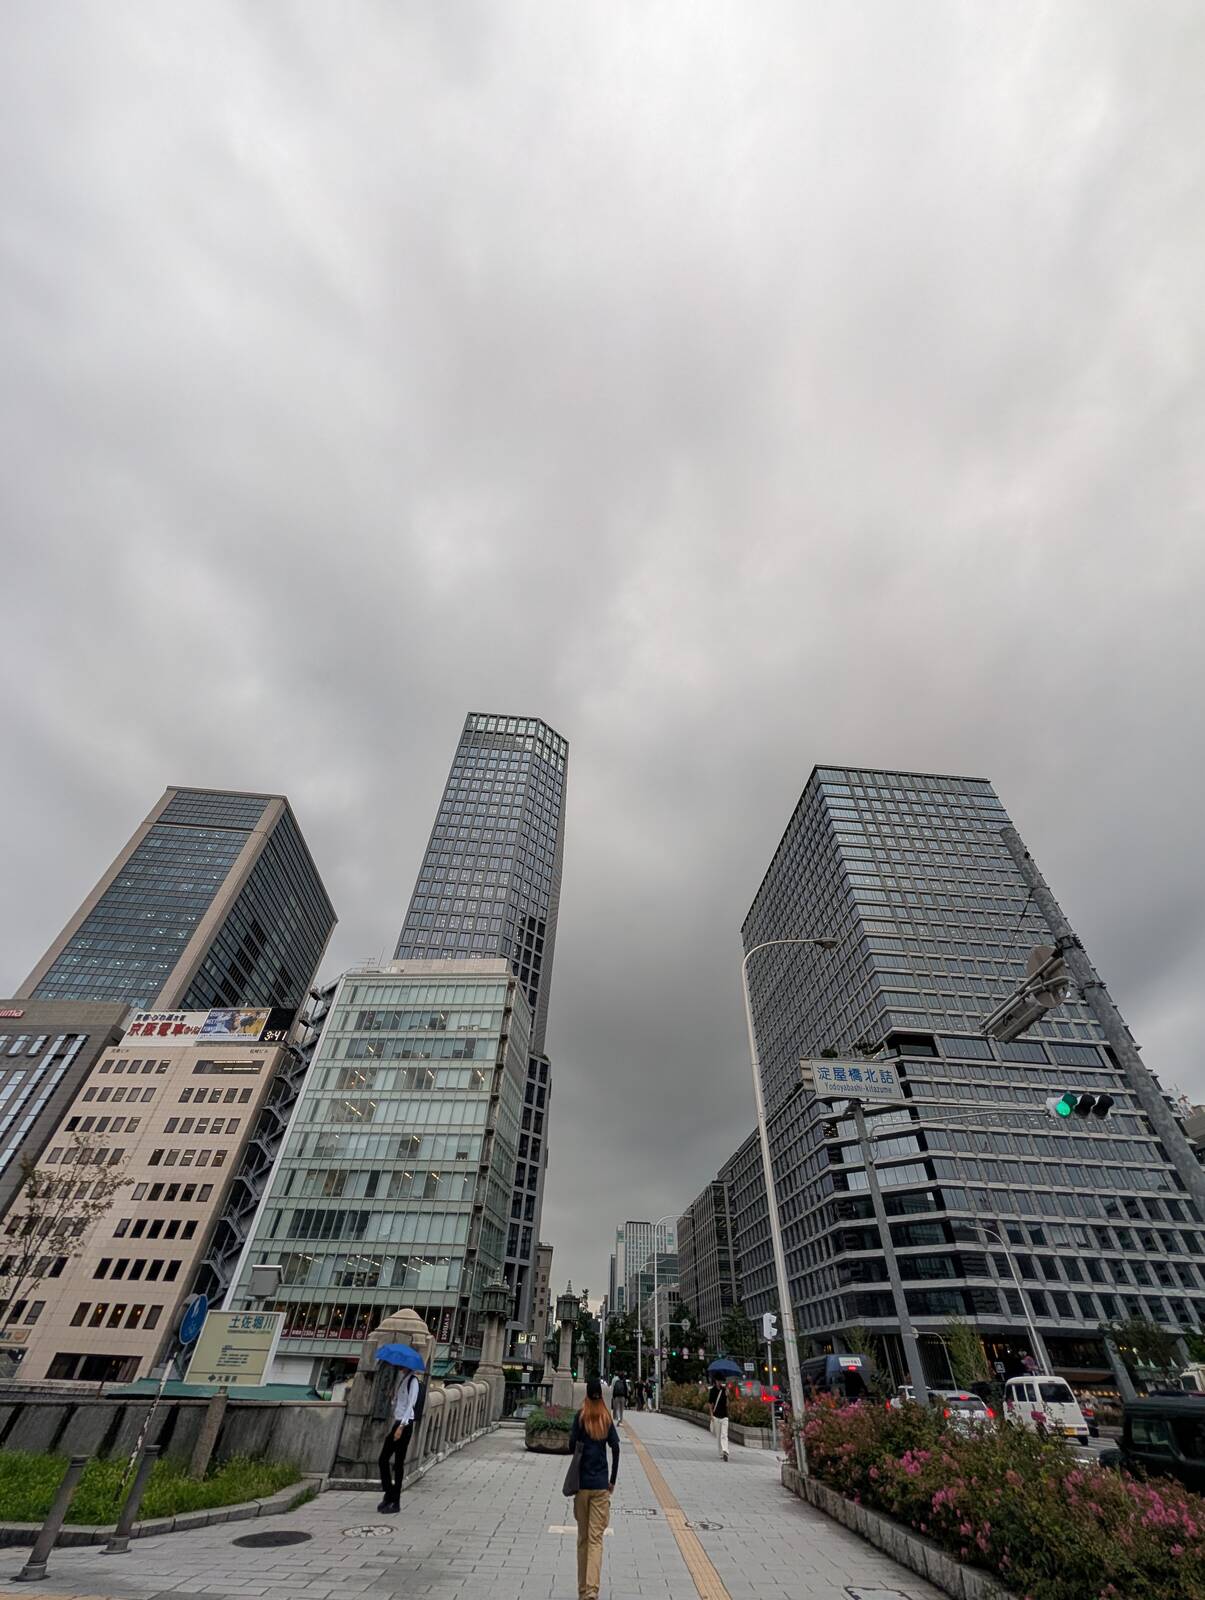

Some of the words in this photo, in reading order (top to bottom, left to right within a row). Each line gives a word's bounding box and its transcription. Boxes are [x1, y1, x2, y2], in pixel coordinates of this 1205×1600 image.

[264, 1030, 288, 1041] 3:41
[817, 1066, 895, 1084] 淀屋橋北詰
[228, 1315, 274, 1329] 土佐堀川
